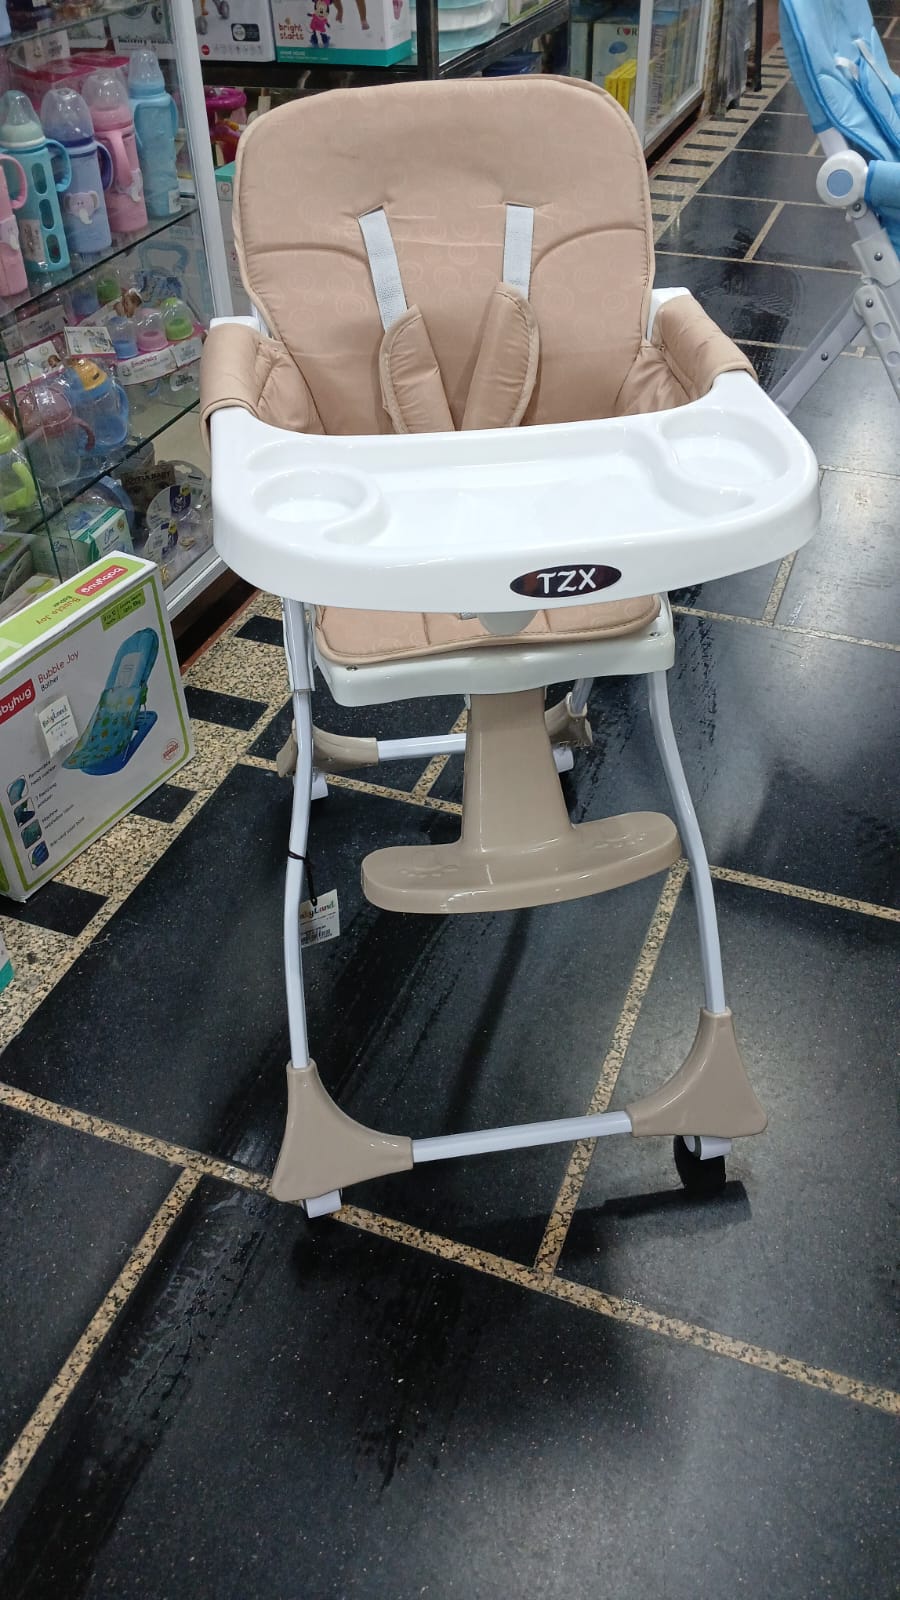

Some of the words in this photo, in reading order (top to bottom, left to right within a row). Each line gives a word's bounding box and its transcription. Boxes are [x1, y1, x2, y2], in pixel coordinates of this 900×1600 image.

[278, 23, 303, 34] bright
[280, 32, 305, 40] starts
[80, 566, 123, 593] babyhug
[536, 567, 597, 594] TZX
[37, 660, 65, 684] Bubble
[66, 650, 79, 664] Joy
